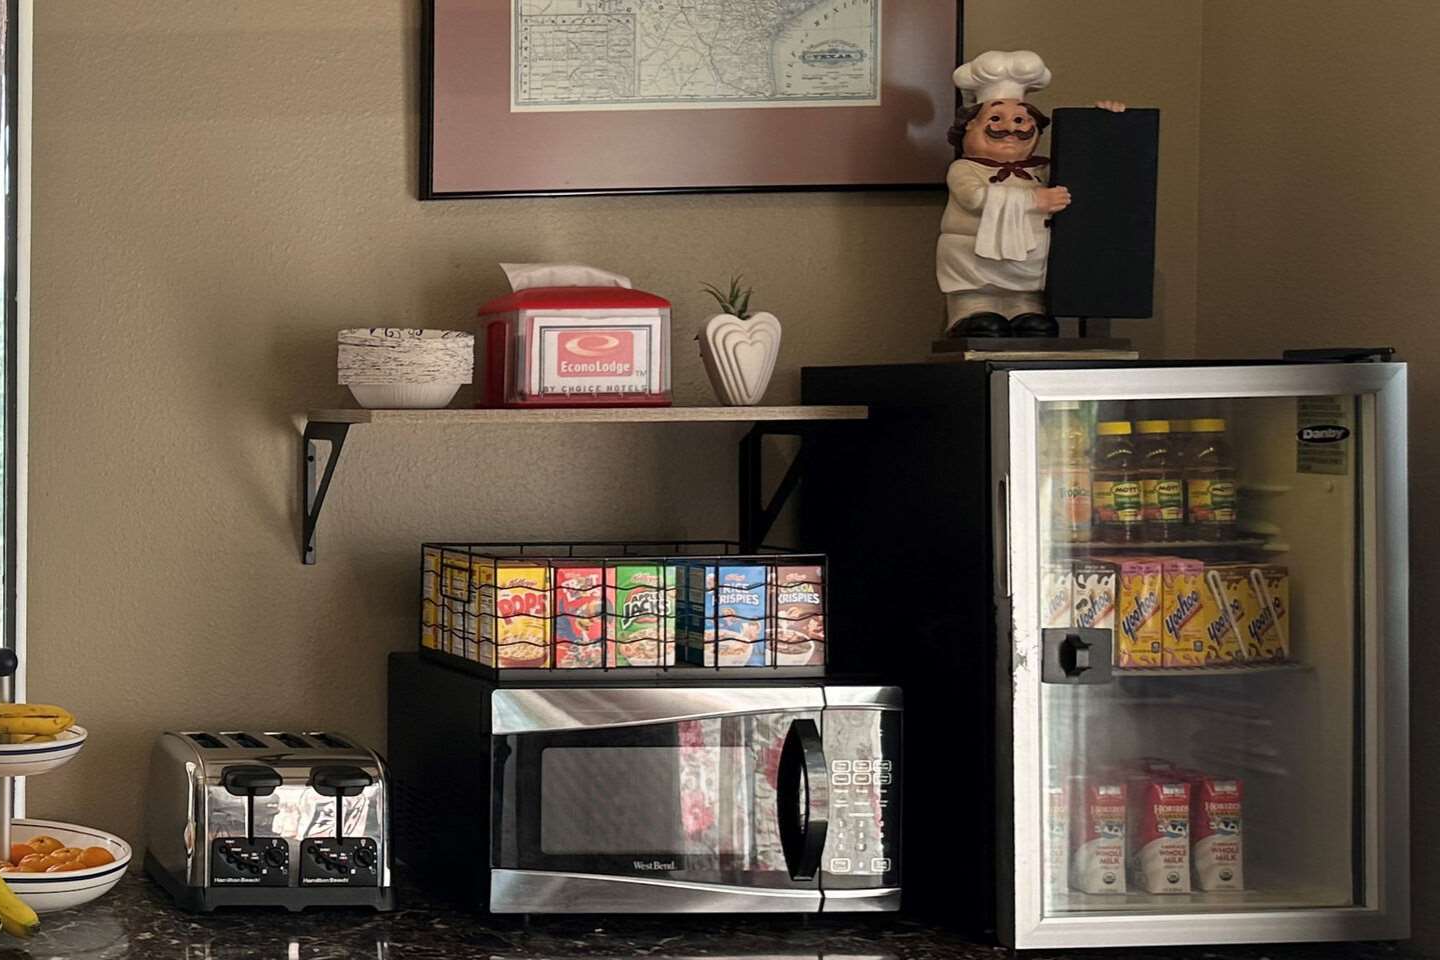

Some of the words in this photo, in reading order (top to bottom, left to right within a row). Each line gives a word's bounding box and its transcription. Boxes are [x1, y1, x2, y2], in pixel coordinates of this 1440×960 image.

[561, 361, 630, 374] EconoLodge
[561, 385, 601, 393] CHOICE
[606, 384, 648, 393] HOTELS
[1303, 428, 1345, 440] Danby
[723, 582, 750, 594] RICE
[498, 592, 547, 625] POPS
[633, 861, 653, 870] West
